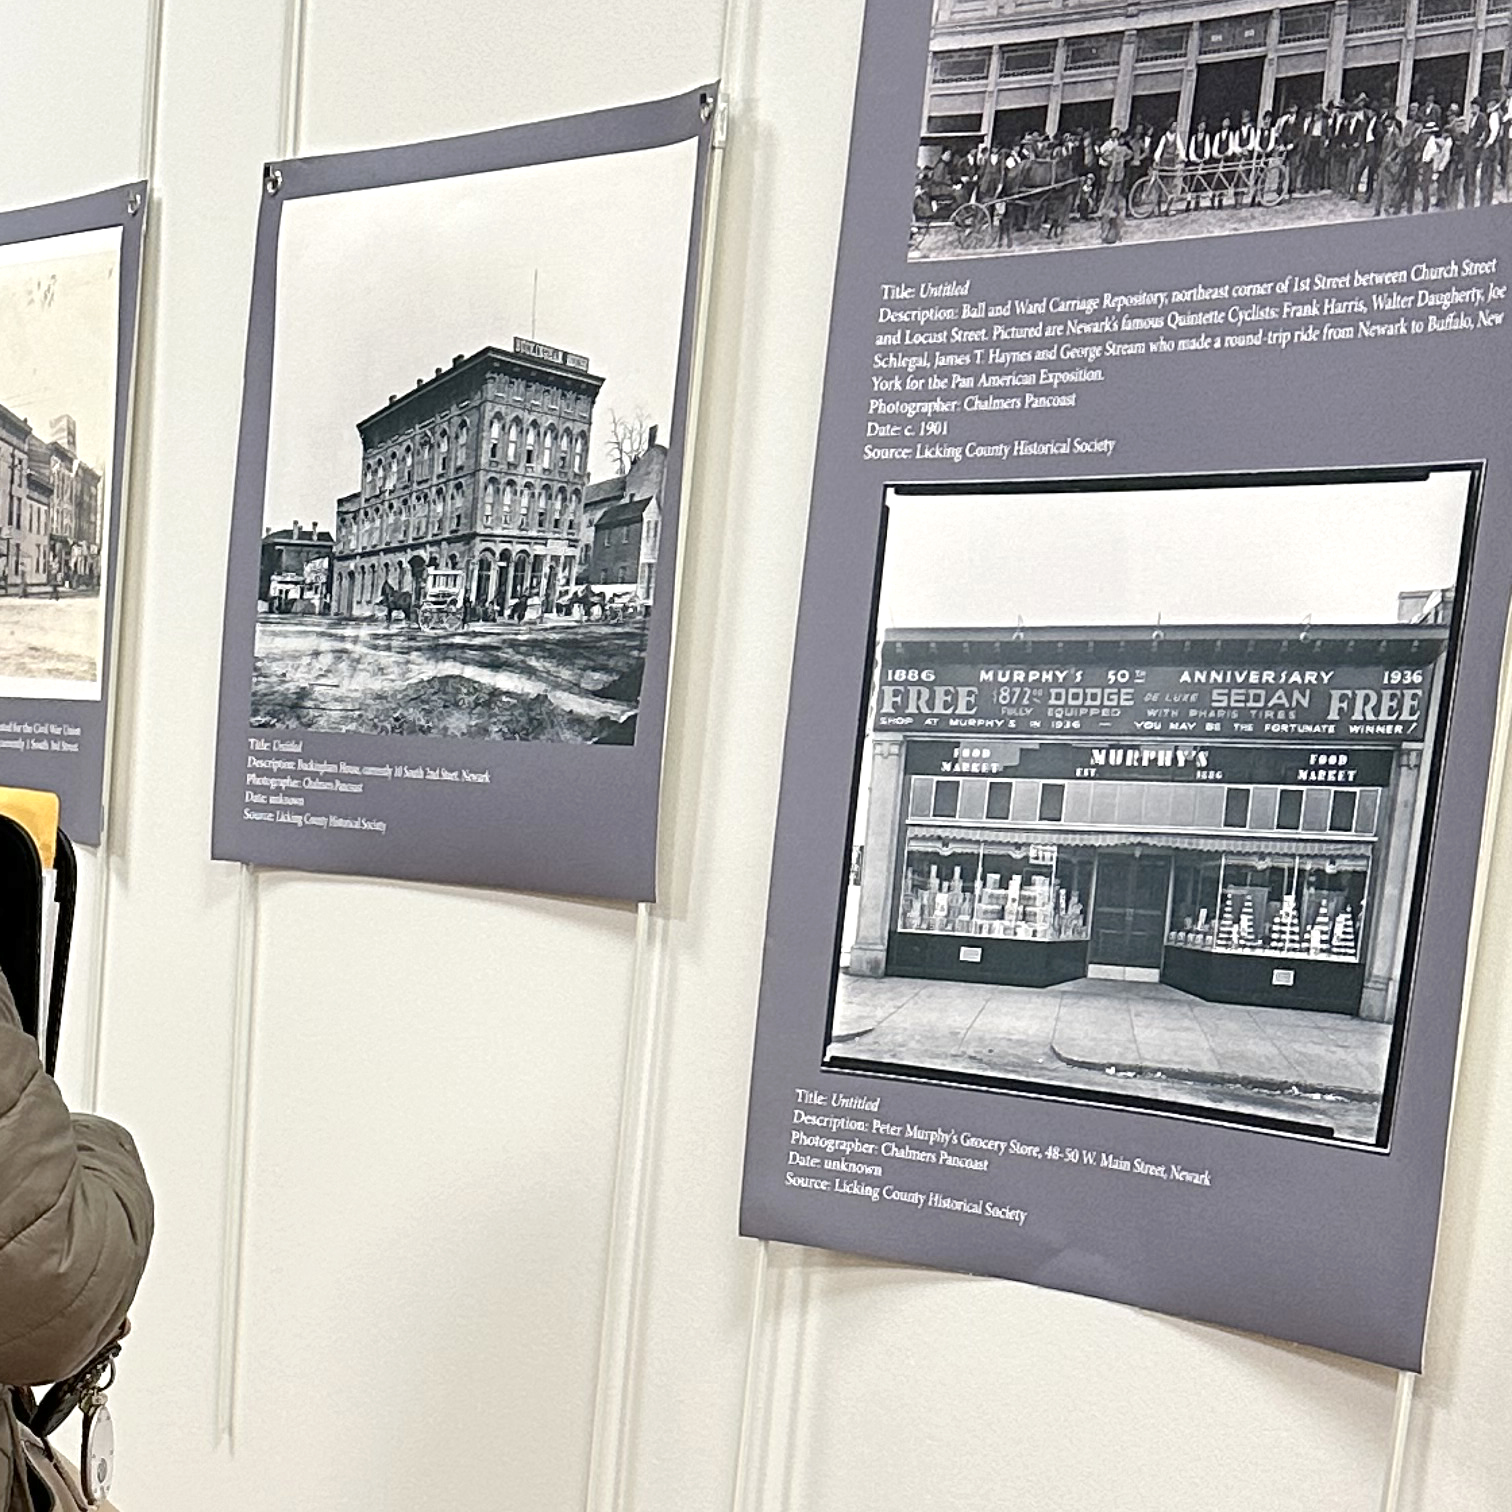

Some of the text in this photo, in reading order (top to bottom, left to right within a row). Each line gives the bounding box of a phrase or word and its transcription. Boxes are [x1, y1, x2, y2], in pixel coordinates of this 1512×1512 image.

[879, 307, 957, 324] Description:
[962, 303, 985, 319] Ball
[988, 300, 1011, 317] and
[1015, 298, 1046, 315] Ward
[1049, 296, 1099, 314] Carriage
[1172, 284, 1229, 302] northeast
[1233, 282, 1271, 298] corner
[1276, 277, 1289, 293] of
[1293, 277, 1310, 292] 1st
[1314, 275, 1350, 290] Street
[1354, 270, 1407, 286] between
[1411, 262, 1458, 281] Church
[1462, 258, 1497, 277] Street
[881, 280, 970, 300] Title: Untitled
[876, 331, 900, 346] and
[904, 330, 948, 345] Locust
[992, 323, 1043, 340] Pictured
[1045, 322, 1064, 337] are
[1121, 315, 1164, 331] famous
[1282, 300, 1320, 318] Frank
[1323, 297, 1368, 315] Harris,
[1372, 293, 1414, 311] Walter
[1487, 282, 1507, 303] Joe
[934, 350, 971, 368] James
[988, 347, 1032, 367] Haynes
[1034, 344, 1057, 360] and
[1059, 343, 1102, 363] George
[1149, 337, 1174, 353] who
[1177, 333, 1211, 351] made
[1213, 336, 1221, 348] a
[1224, 328, 1290, 349] round-trip
[1294, 323, 1320, 343] ride
[1323, 321, 1353, 340] from
[1357, 319, 1408, 338] Newark
[1412, 320, 1423, 333] to
[1427, 311, 1474, 332] Buffalo,
[1477, 310, 1504, 327] New
[871, 376, 902, 392] York
[906, 374, 923, 390] for
[928, 373, 948, 390] the
[951, 373, 974, 389] Pan
[978, 370, 1036, 387] American
[868, 392, 1076, 417] Photographer: Chalmers Pancoast
[919, 421, 948, 435] 1901
[915, 442, 962, 461] Licking
[965, 441, 1010, 459] County
[1014, 438, 1070, 455] Historical
[1073, 438, 1115, 456] Society
[887, 669, 935, 682] 1886
[980, 668, 1083, 683] MURPHY'S
[1180, 670, 1334, 683] ANNIVERSARY
[1383, 670, 1423, 684] 1936
[880, 685, 978, 715] FREE
[1049, 688, 1135, 706] DODGE
[1211, 688, 1310, 708] SEDAN
[1327, 688, 1423, 721] FREE
[1047, 708, 1120, 718] EQUIPPED
[1146, 707, 1179, 719] WITH
[1250, 710, 1297, 719] TIRES
[879, 717, 914, 725] SHOP
[1051, 720, 1081, 729] 1936
[1133, 720, 1162, 731] YOU
[1169, 722, 1196, 731] MAY
[1206, 722, 1221, 731] BE
[1233, 723, 1253, 732] THE
[1264, 723, 1336, 733] FORTUNATE
[952, 747, 991, 758] FOOD
[1090, 748, 1208, 767] MURPHY'S
[1310, 754, 1348, 765] FOOD
[941, 761, 1000, 773] MARKET
[1297, 770, 1357, 782] MARKET
[795, 1089, 880, 1112] Title: Untitled
[790, 1131, 988, 1172] Photographer: Chalmers Pancoast
[793, 1110, 868, 1133] Description:
[872, 1120, 902, 1137] Peter
[960, 1133, 1007, 1155] Grocery
[1010, 1138, 1043, 1158] Store,
[1045, 1146, 1079, 1163] 48-50
[1082, 1150, 1096, 1165] W.
[1100, 1153, 1130, 1171] Main
[1170, 1164, 1211, 1186] Newark
[788, 1152, 882, 1176] Date: unknown
[785, 1173, 1027, 1225] Source: Licking County Historical Society
